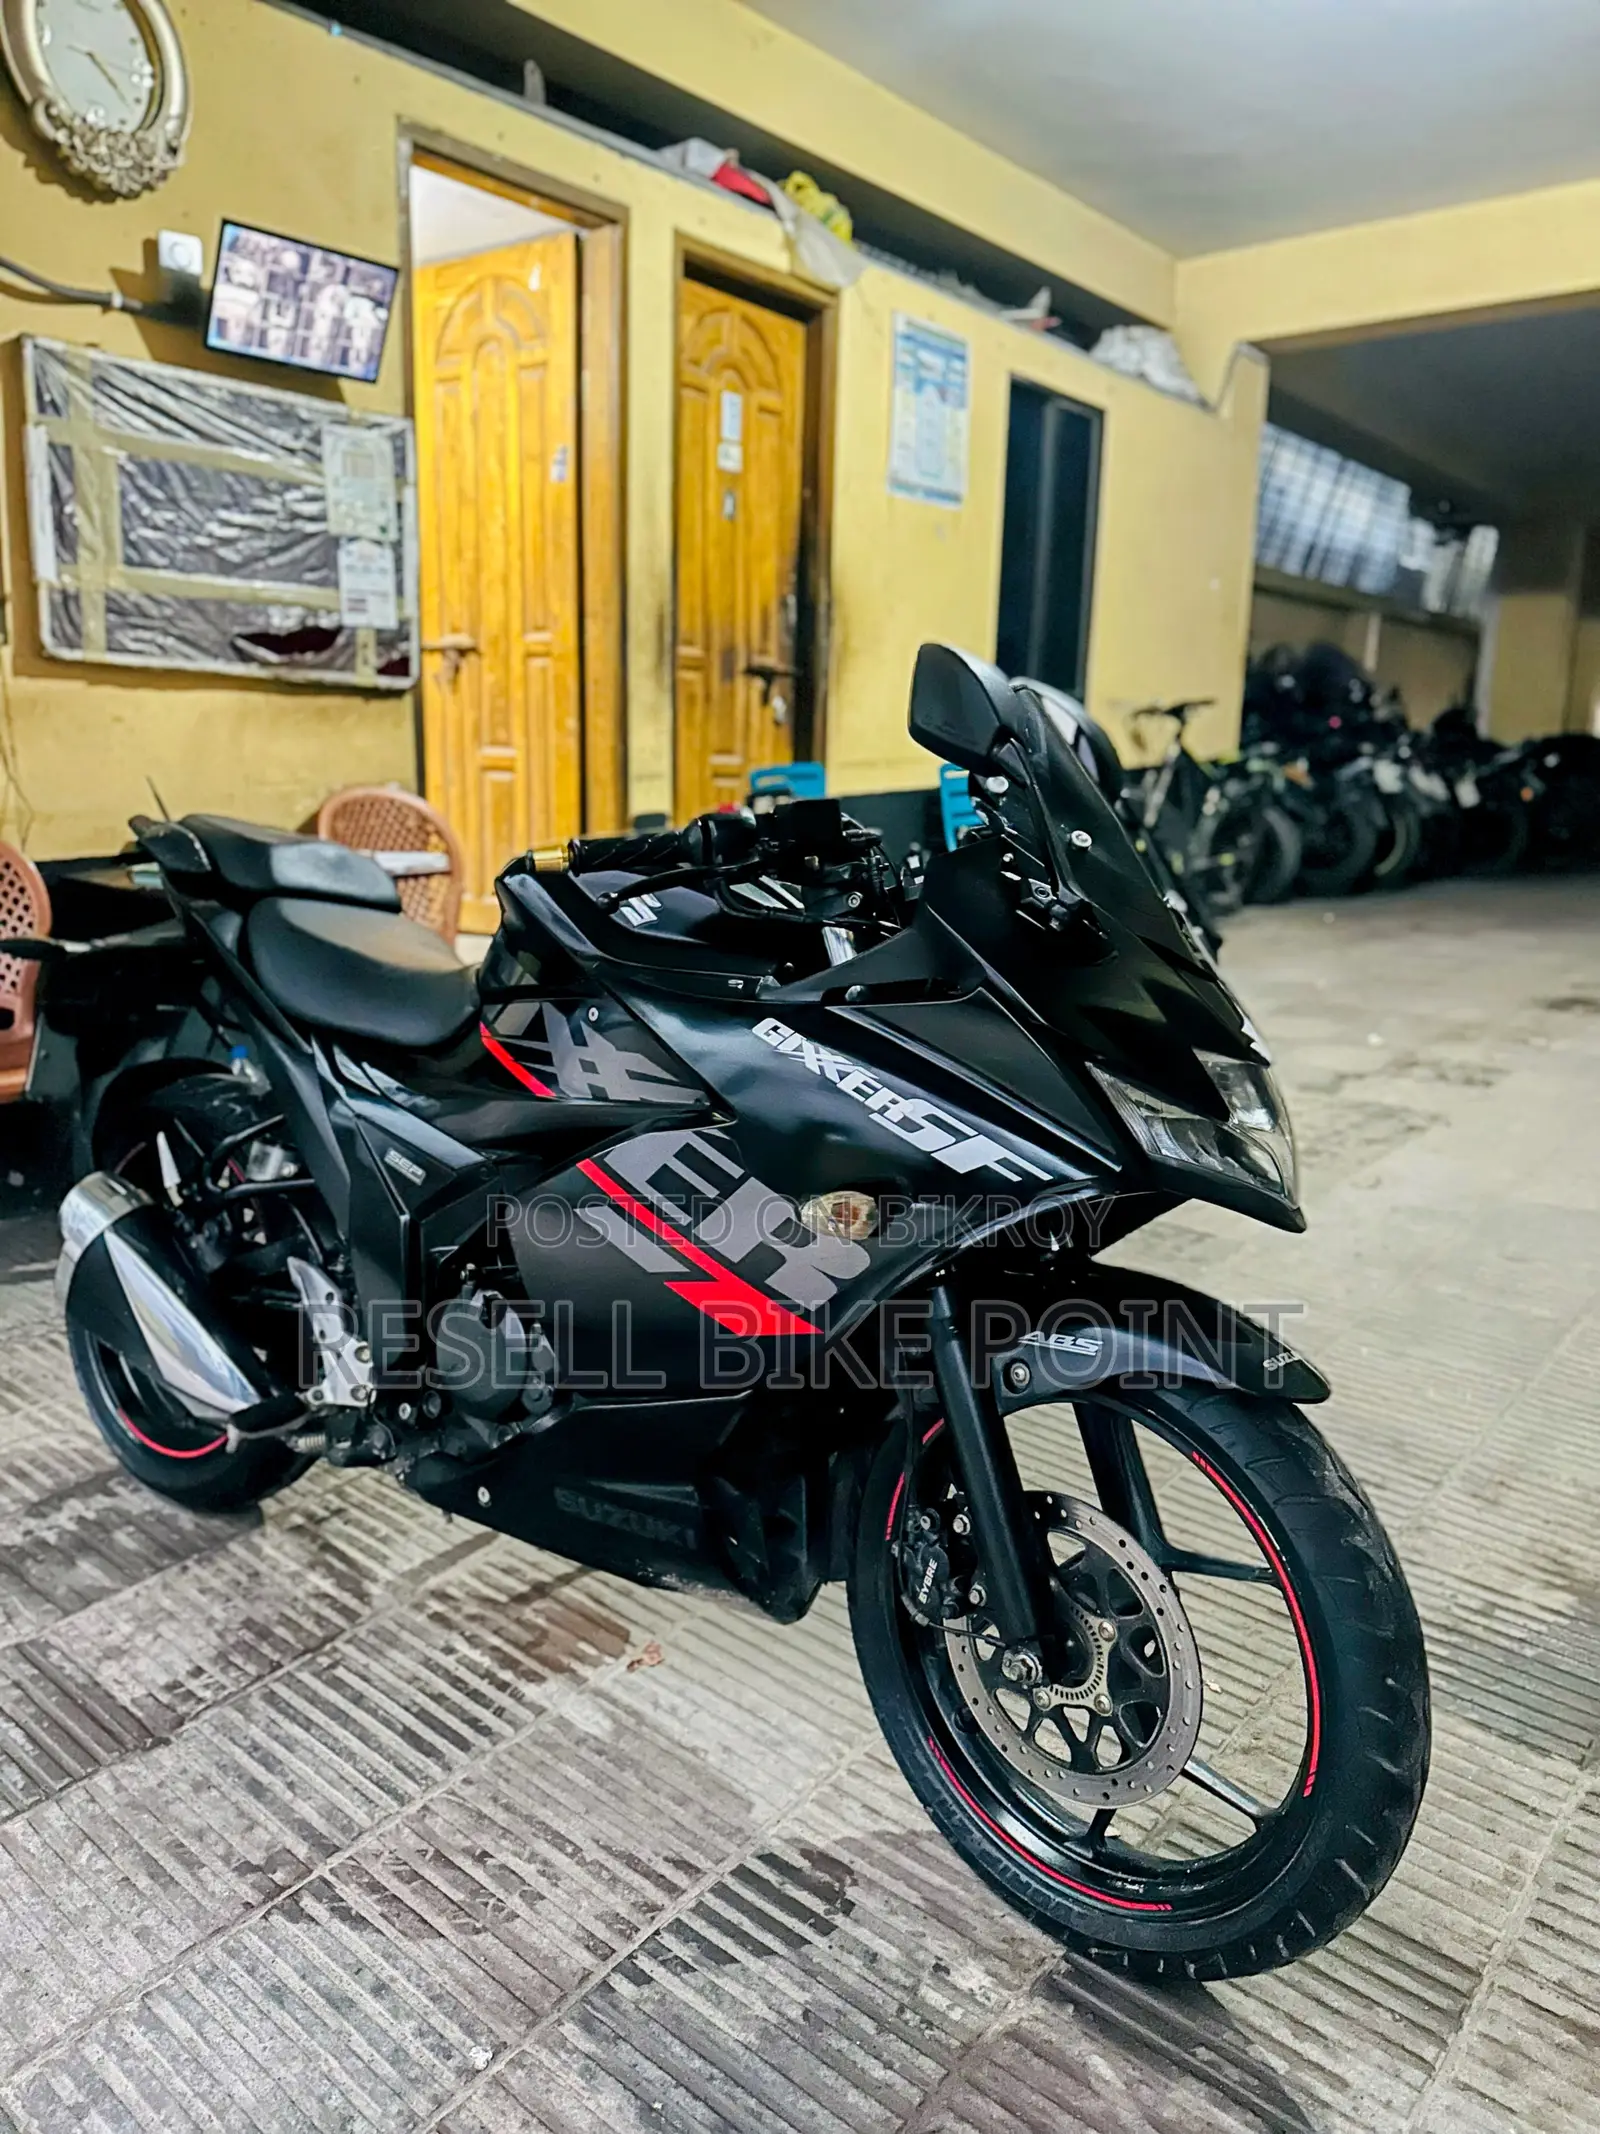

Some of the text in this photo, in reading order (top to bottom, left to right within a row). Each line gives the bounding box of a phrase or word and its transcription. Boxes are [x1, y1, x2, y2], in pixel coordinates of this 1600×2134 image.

[752, 1017, 915, 1123] GIXXER
[1018, 1330, 1104, 1352] ABS
[553, 1485, 697, 1551] SUZUKI
[918, 1557, 938, 1605] BYBRE
